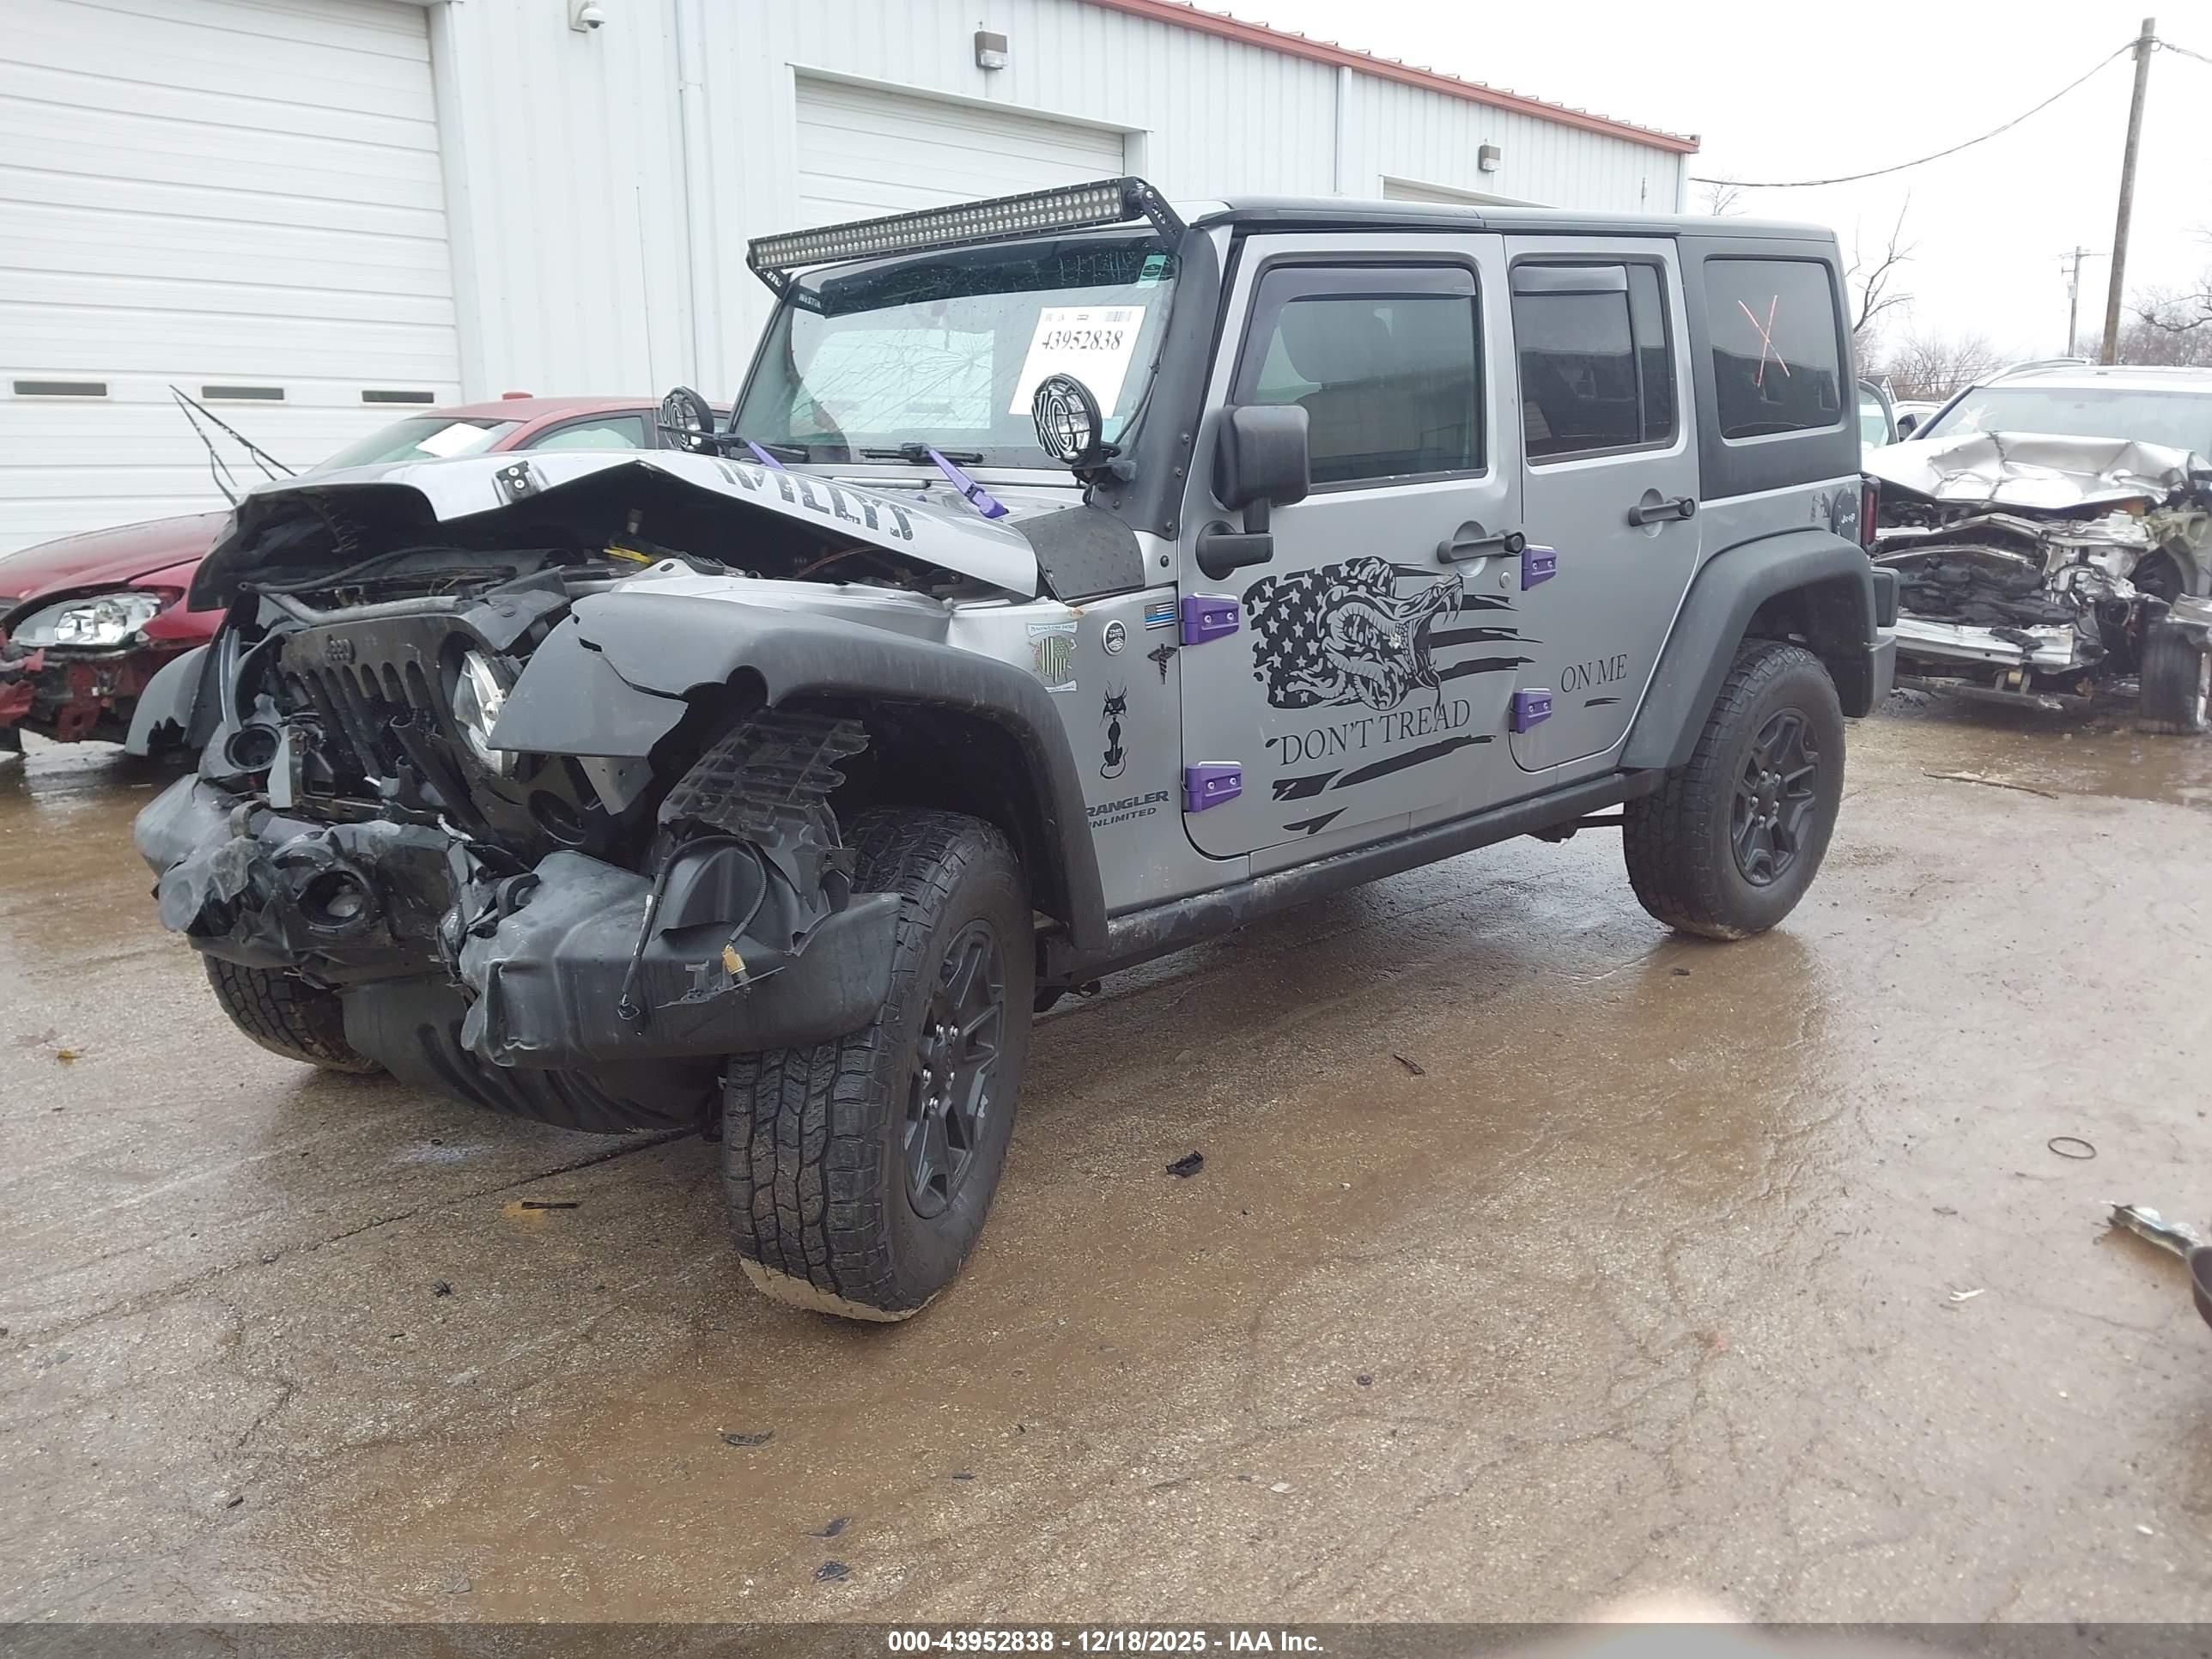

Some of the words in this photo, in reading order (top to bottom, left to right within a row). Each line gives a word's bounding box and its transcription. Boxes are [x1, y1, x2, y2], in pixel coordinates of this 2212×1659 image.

[1042, 330, 1123, 350] 43952838
[1031, 391, 1073, 459] KC
[1560, 661, 1592, 693] ON
[1596, 653, 1627, 684] ME
[1280, 718, 1374, 766] DON'T
[1378, 699, 1471, 744] TREAD
[1085, 790, 1170, 817] RANGLER
